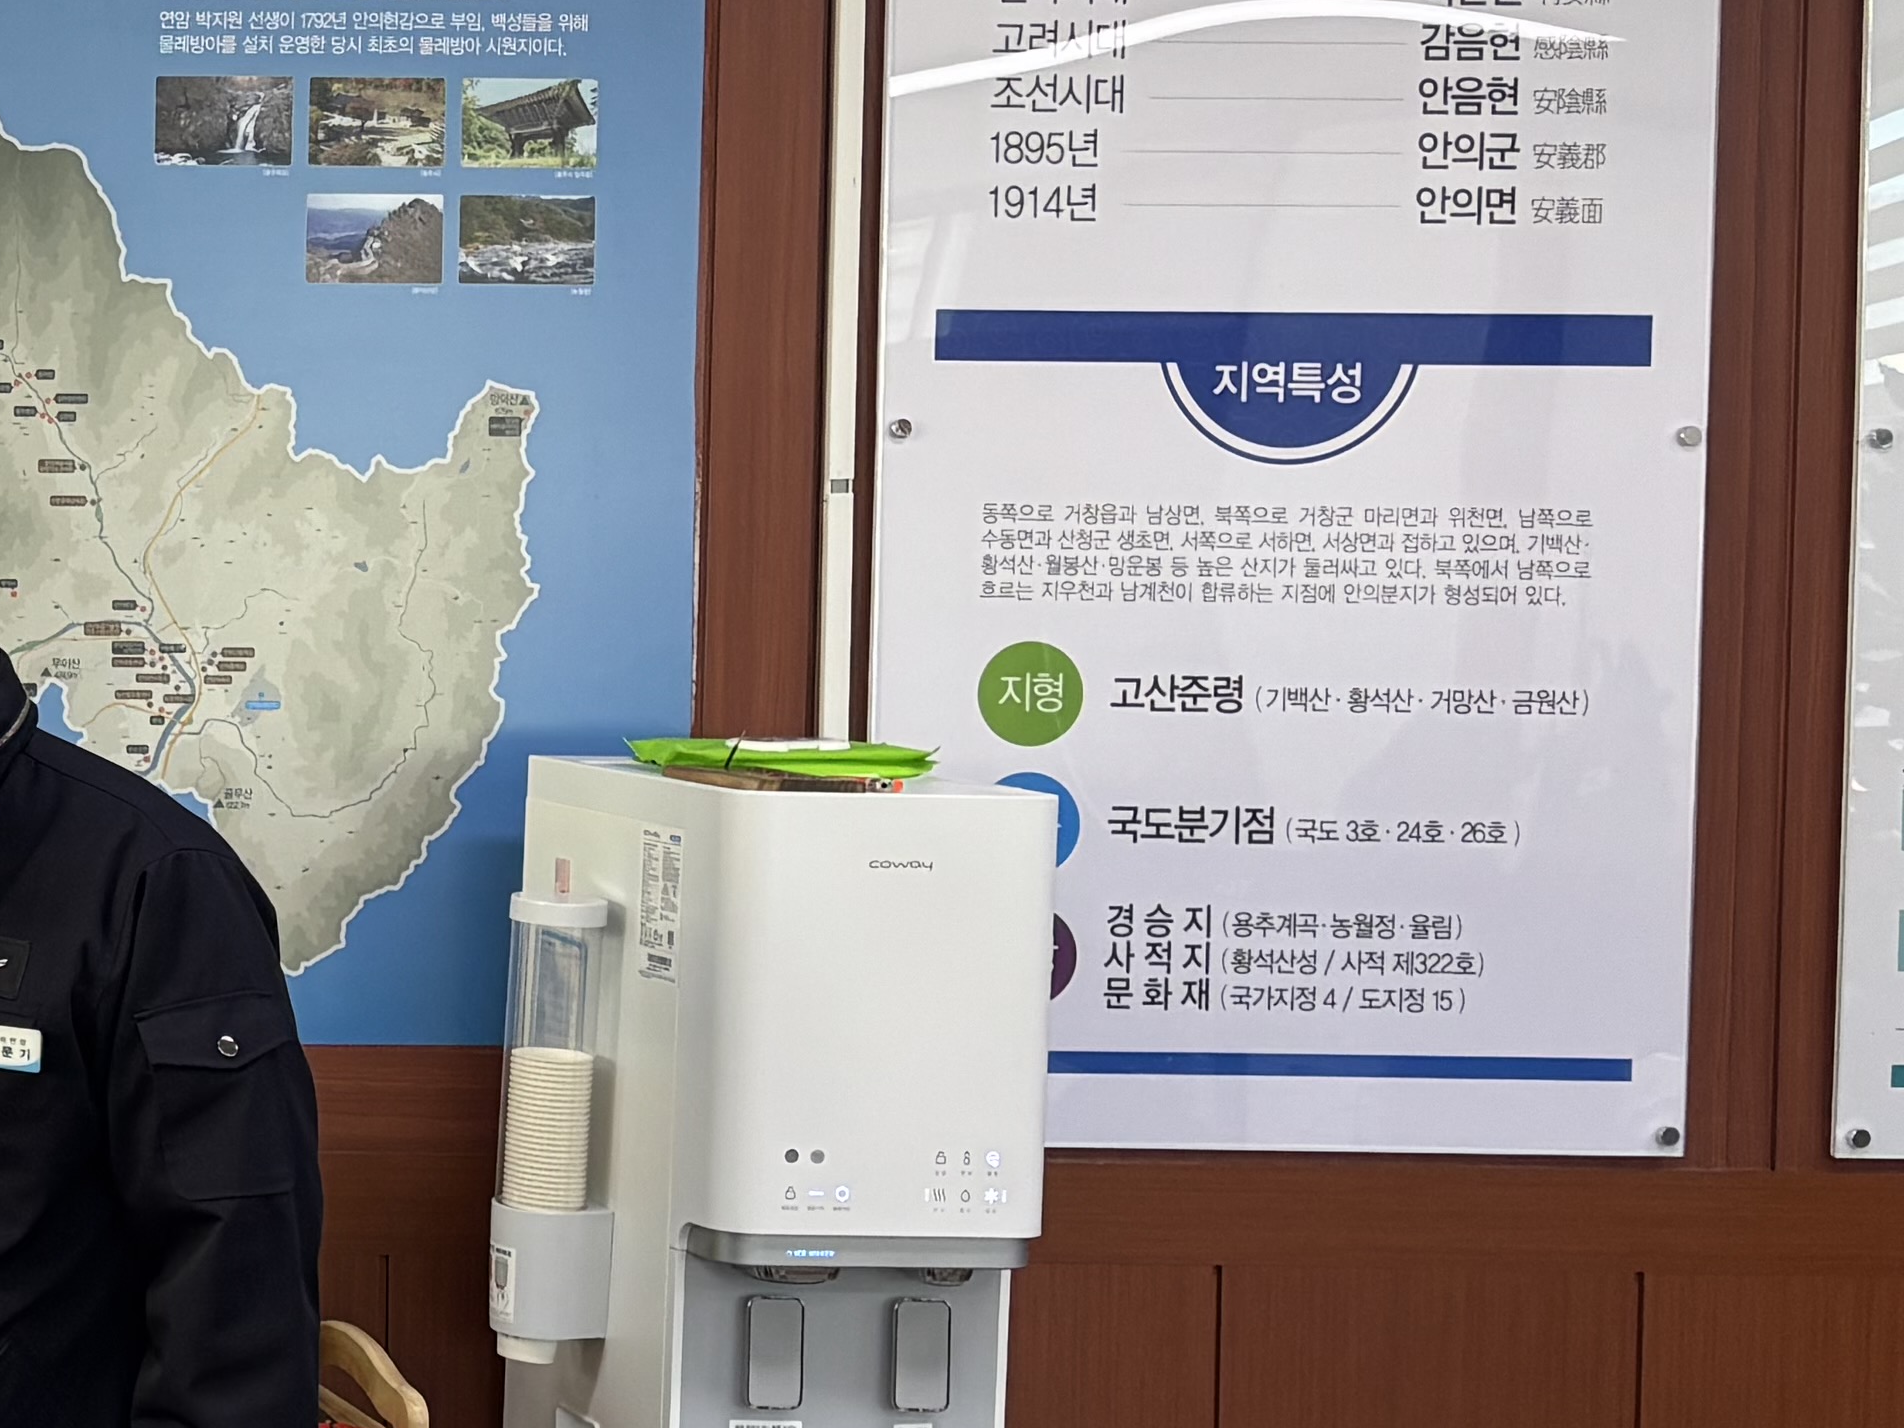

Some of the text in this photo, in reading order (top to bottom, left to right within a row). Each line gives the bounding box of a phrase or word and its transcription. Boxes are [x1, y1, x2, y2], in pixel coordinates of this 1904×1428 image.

[991, 74, 1124, 114] 조선시대
[1419, 77, 1518, 115] 안음현
[991, 129, 1098, 167] 1895년
[1419, 131, 1520, 171] 안의군
[989, 183, 1096, 221] 1914년
[1416, 186, 1516, 225] 안의면
[1213, 361, 1361, 403] 지역특성
[982, 502, 1594, 530] 동쪽으로 거창읍과 남상면, 북쪽으로 거창군 마리면과 위천면, 남쪽으로
[980, 528, 1053, 551] 수동면과
[1057, 528, 1112, 551] 산청군
[1116, 529, 1174, 552] 생초면,
[1180, 530, 1254, 552] 서쪽으로
[1258, 530, 1316, 553] 서하면,
[1322, 531, 1395, 554] 서상면과
[1400, 532, 1457, 554] 접하고
[1461, 532, 1521, 555] 있으며,
[1169, 555, 1190, 578] 등
[1195, 555, 1234, 578] 높은
[1240, 556, 1297, 579] 산지가
[1303, 557, 1378, 579] 둘러싸고
[1385, 557, 1427, 580] 있다.
[1433, 558, 1509, 581] 북쪽에서
[1516, 558, 1593, 581] 남쪽으로
[978, 580, 1567, 607] 흐르는 지우천과 남계천이 합류하는 지점에 안의분지가 형성되어 있다.
[998, 673, 1063, 712] 지형
[1110, 674, 1243, 714] 고산준령
[1108, 806, 1274, 845] 국도분기점
[869, 858, 934, 871] coway
[1341, 950, 1384, 976] 사적
[1323, 988, 1336, 1009] 4
[1359, 988, 1424, 1013] 도지정
